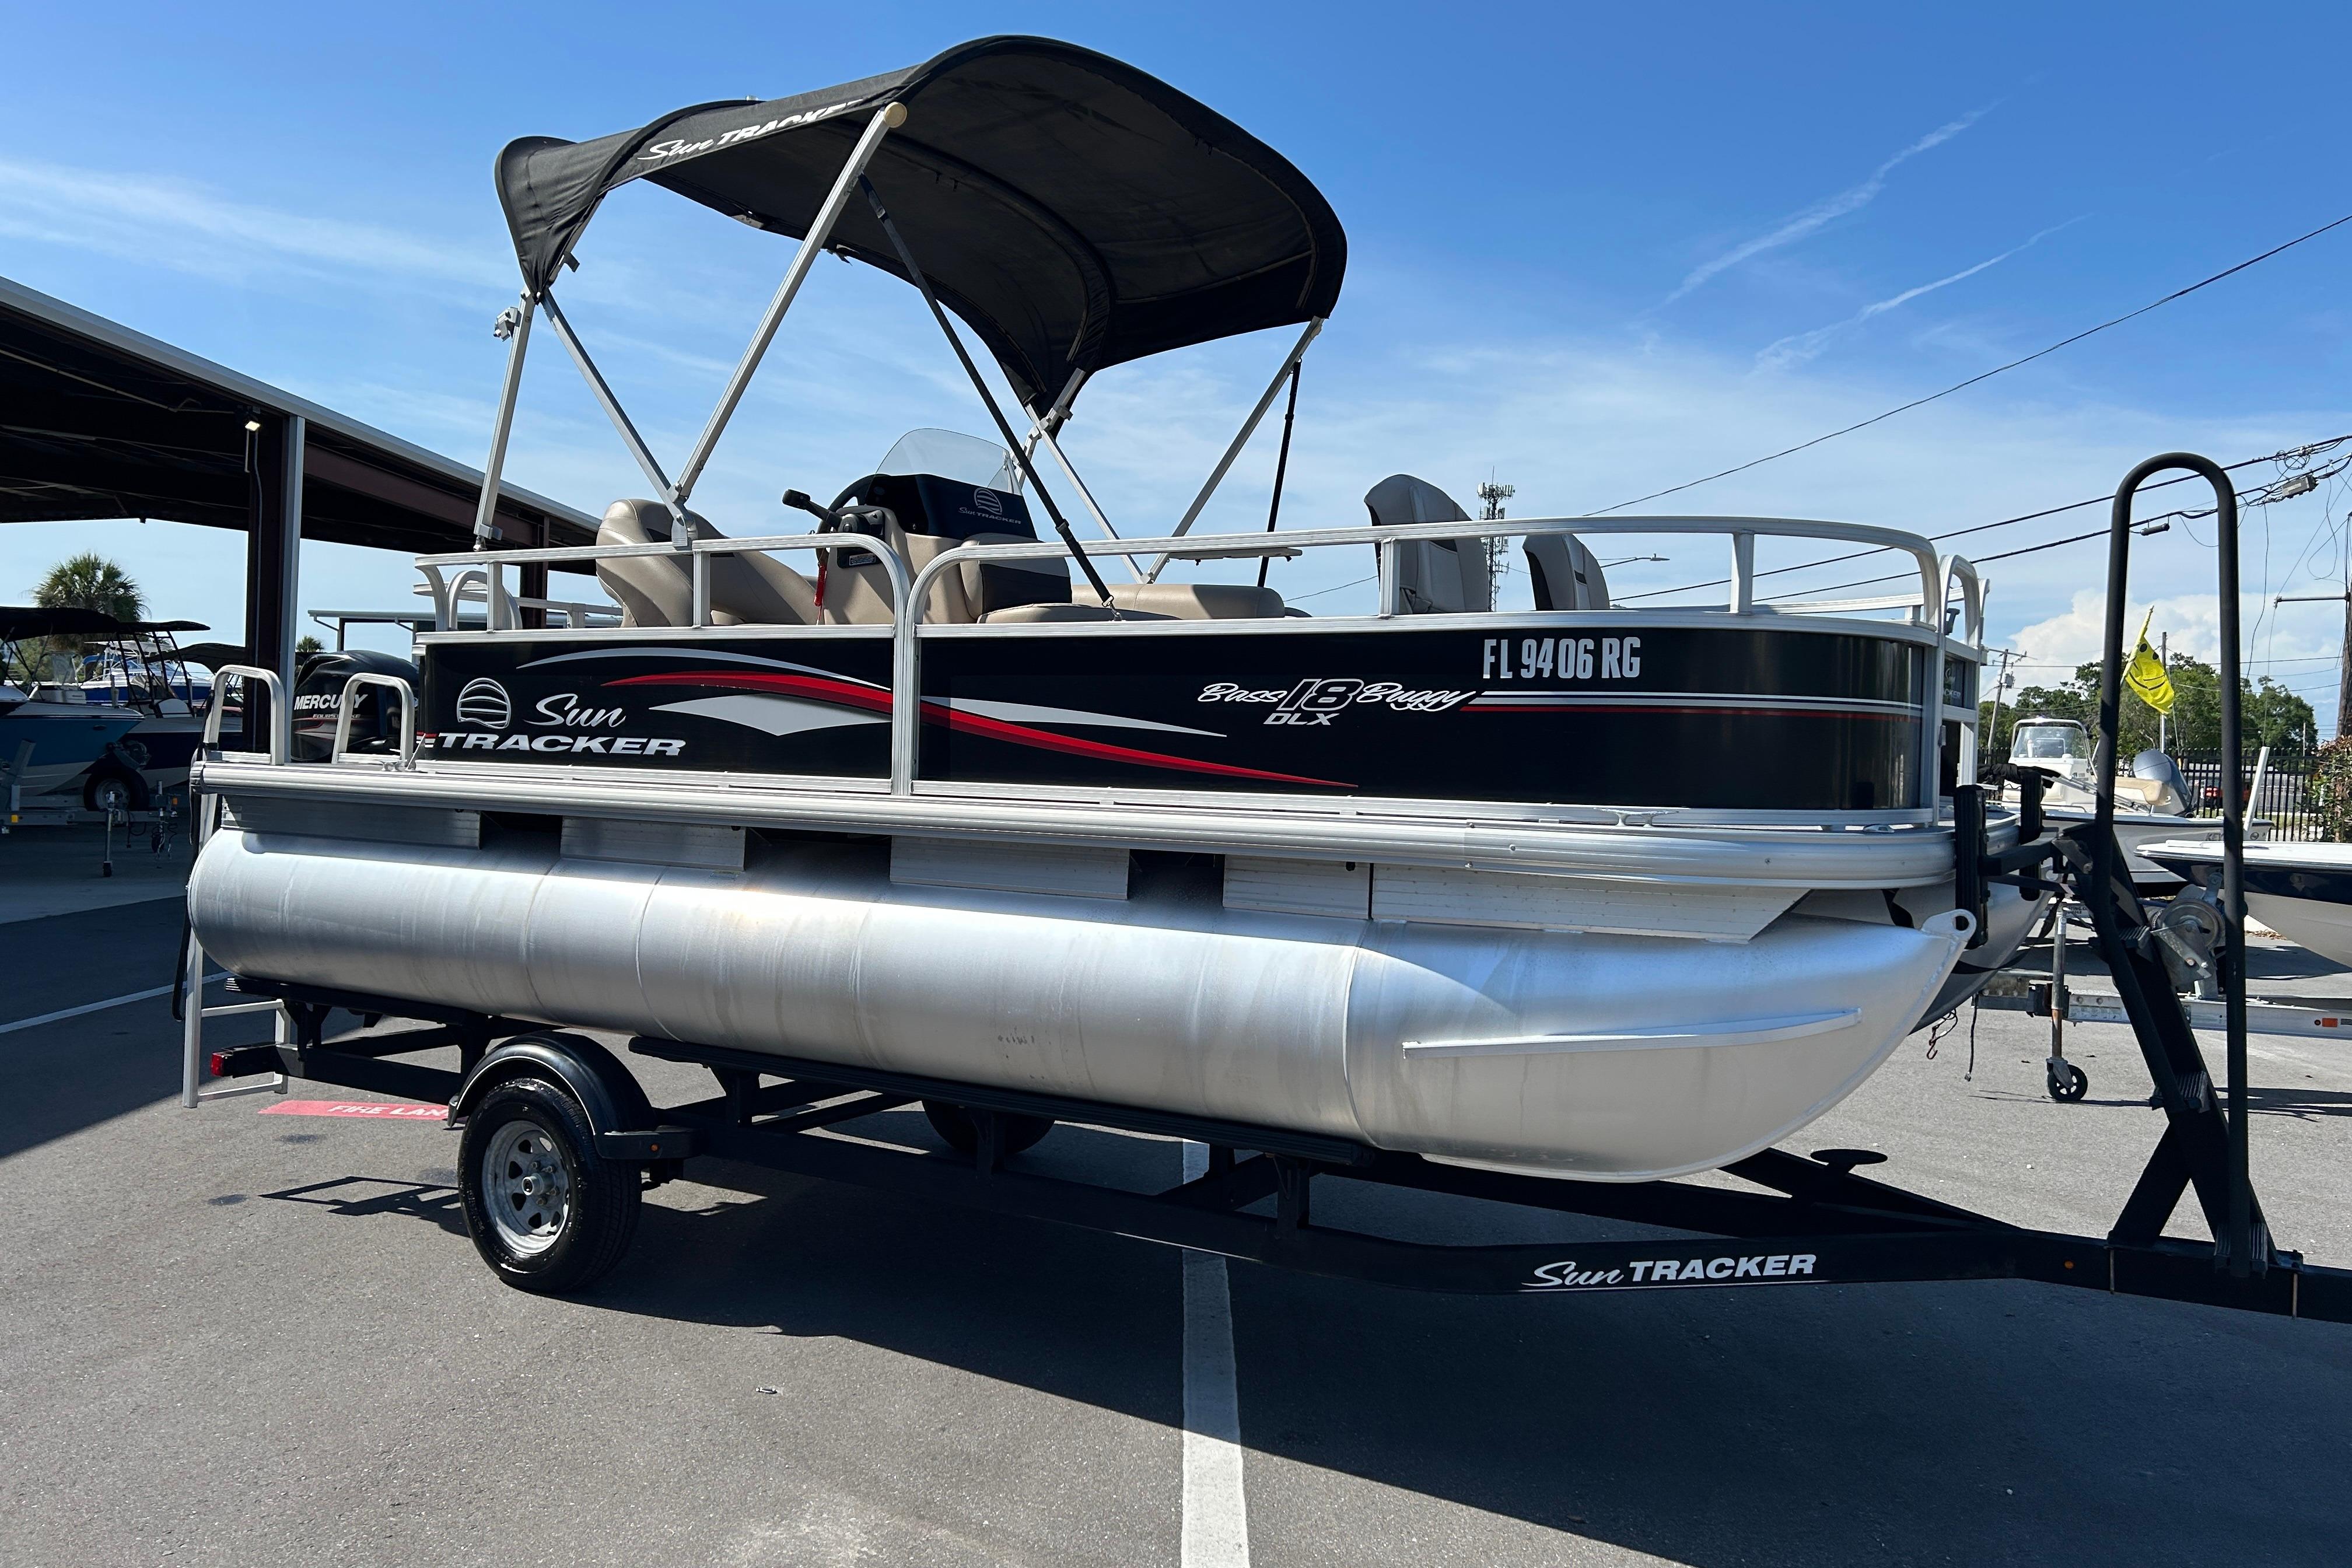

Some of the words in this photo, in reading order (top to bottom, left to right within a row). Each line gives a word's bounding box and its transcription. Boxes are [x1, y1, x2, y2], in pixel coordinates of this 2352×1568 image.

[637, 139, 715, 160] Sun
[958, 506, 975, 515] Sun
[975, 512, 1021, 524] TRACKER
[1482, 639, 1513, 679] FL
[1520, 638, 1594, 679] 9406
[1601, 636, 1642, 678] RG
[294, 694, 368, 710] MERCUY
[1197, 682, 1288, 702] Bass
[1276, 678, 1365, 711] 18
[1356, 682, 1476, 712] Buggy
[523, 693, 628, 728] Sun
[1263, 713, 1340, 726] DLX
[438, 732, 687, 757] TRACKER
[328, 1105, 390, 1114] FIRE
[388, 1108, 449, 1116] LAN
[1521, 1261, 1624, 1286] Sun
[1629, 1254, 1817, 1282] TRACKER
